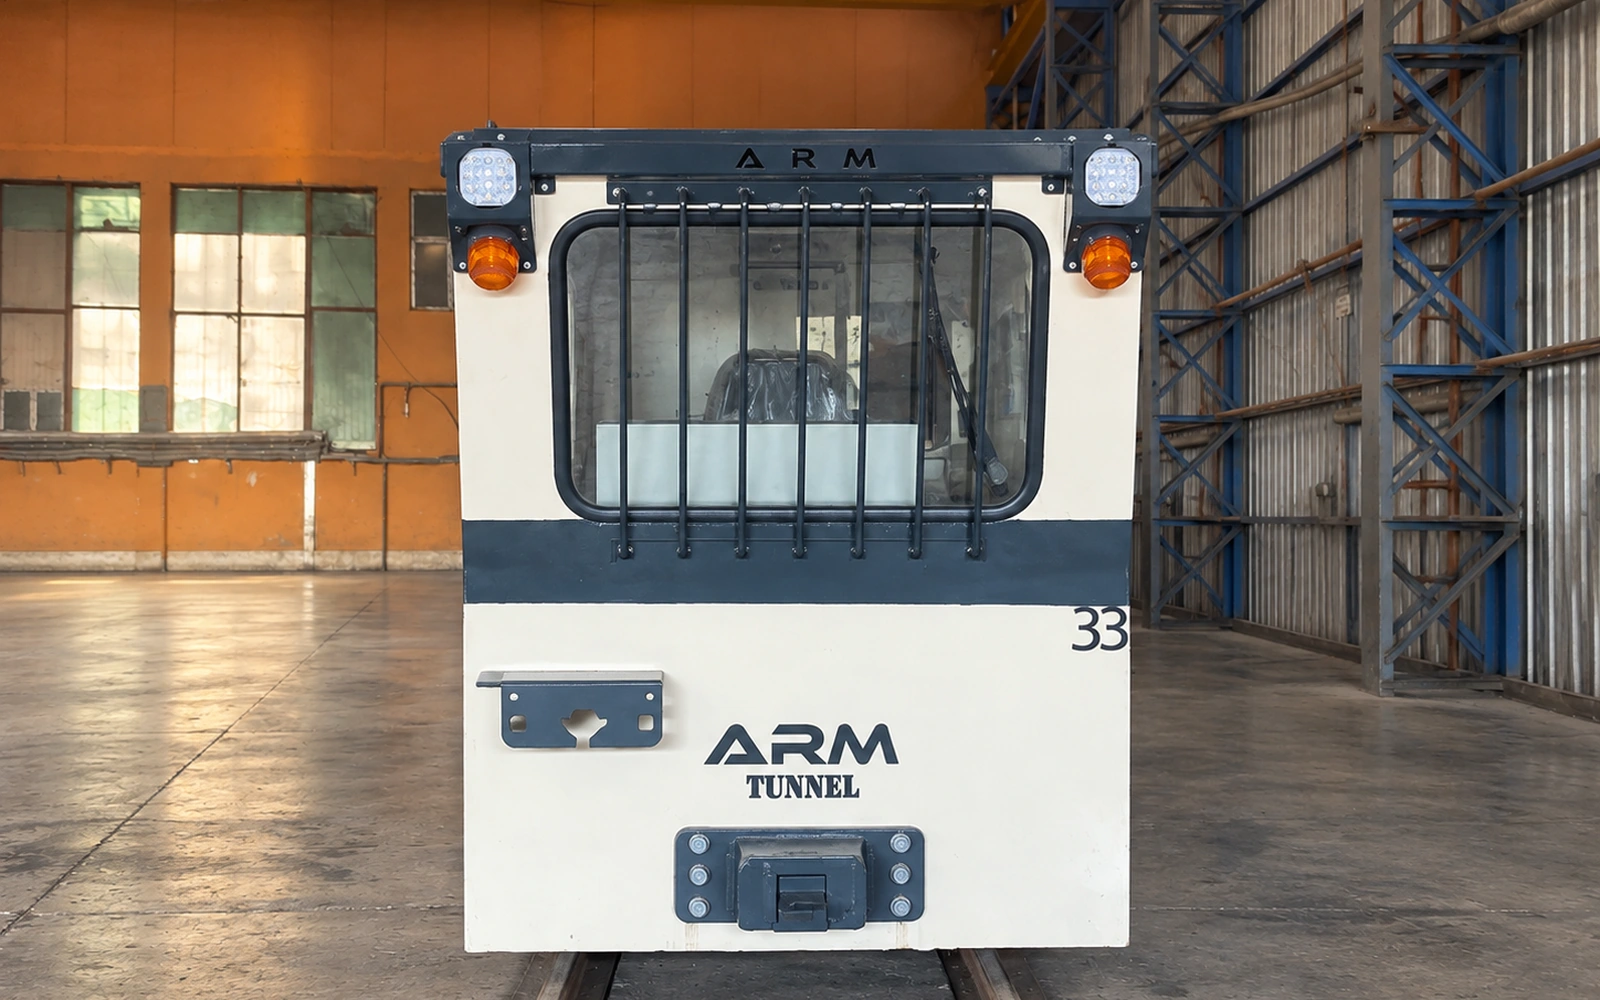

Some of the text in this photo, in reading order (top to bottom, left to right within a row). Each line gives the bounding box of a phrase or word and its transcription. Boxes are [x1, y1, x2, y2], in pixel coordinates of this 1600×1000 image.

[735, 147, 877, 169] ARM
[1072, 606, 1128, 651] 33
[703, 723, 899, 765] ARM
[746, 774, 860, 799] TUNNEL
